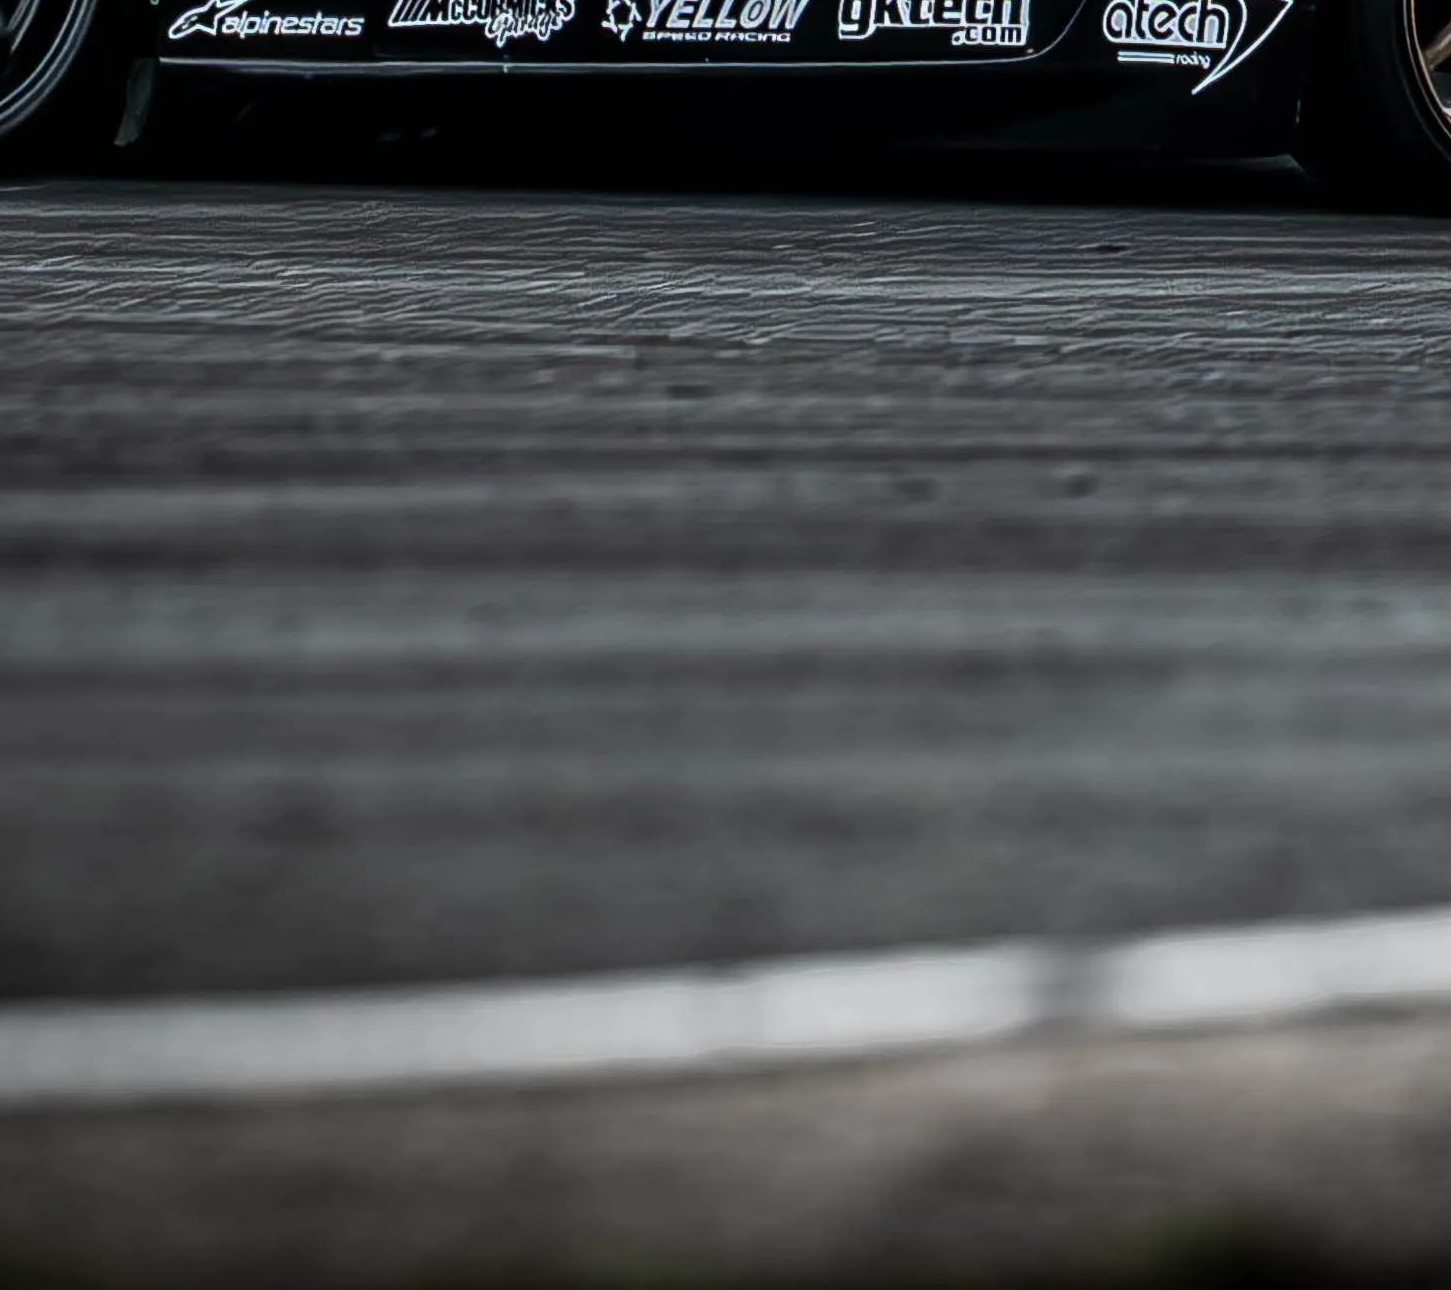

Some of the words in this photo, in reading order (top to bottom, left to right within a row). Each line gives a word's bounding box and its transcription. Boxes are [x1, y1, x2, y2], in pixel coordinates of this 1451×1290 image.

[221, 10, 365, 39] alpinestars
[642, 30, 712, 41] SPEED
[715, 31, 792, 43] RACING
[951, 26, 1024, 46] .com
